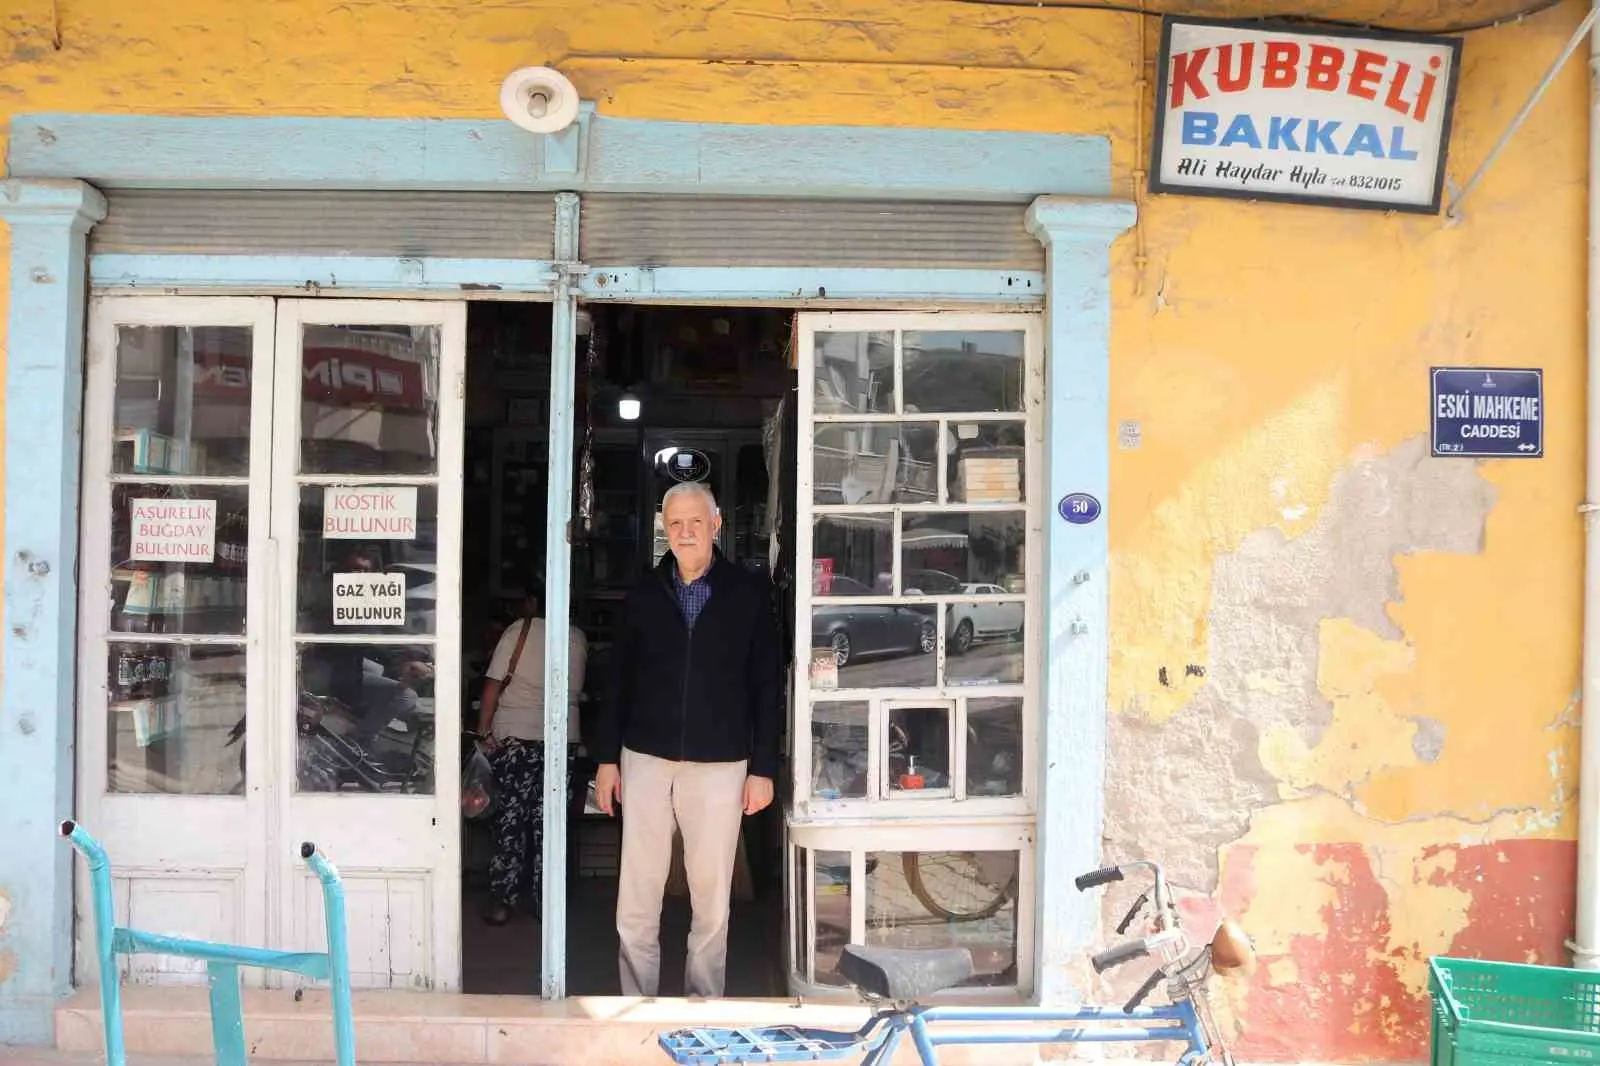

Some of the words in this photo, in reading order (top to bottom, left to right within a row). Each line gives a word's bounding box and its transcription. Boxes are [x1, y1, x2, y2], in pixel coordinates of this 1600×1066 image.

[1170, 42, 1441, 123] KUBBELİ
[1182, 111, 1418, 160] BAKKAL
[1177, 158, 1206, 176] Ali
[1216, 161, 1282, 184] Haydar
[1349, 175, 1402, 191] 8321015
[1438, 389, 1469, 418] ESKİ
[1473, 395, 1539, 420] MAHKEME
[1460, 422, 1521, 439] CADDESİ
[1073, 500, 1088, 513] 50
[325, 517, 414, 533] BULUNUR
[135, 541, 212, 556] BULUNUR
[336, 584, 364, 597] GAZ
[370, 581, 402, 597] YAĞI
[336, 607, 402, 620] BULUNUR
